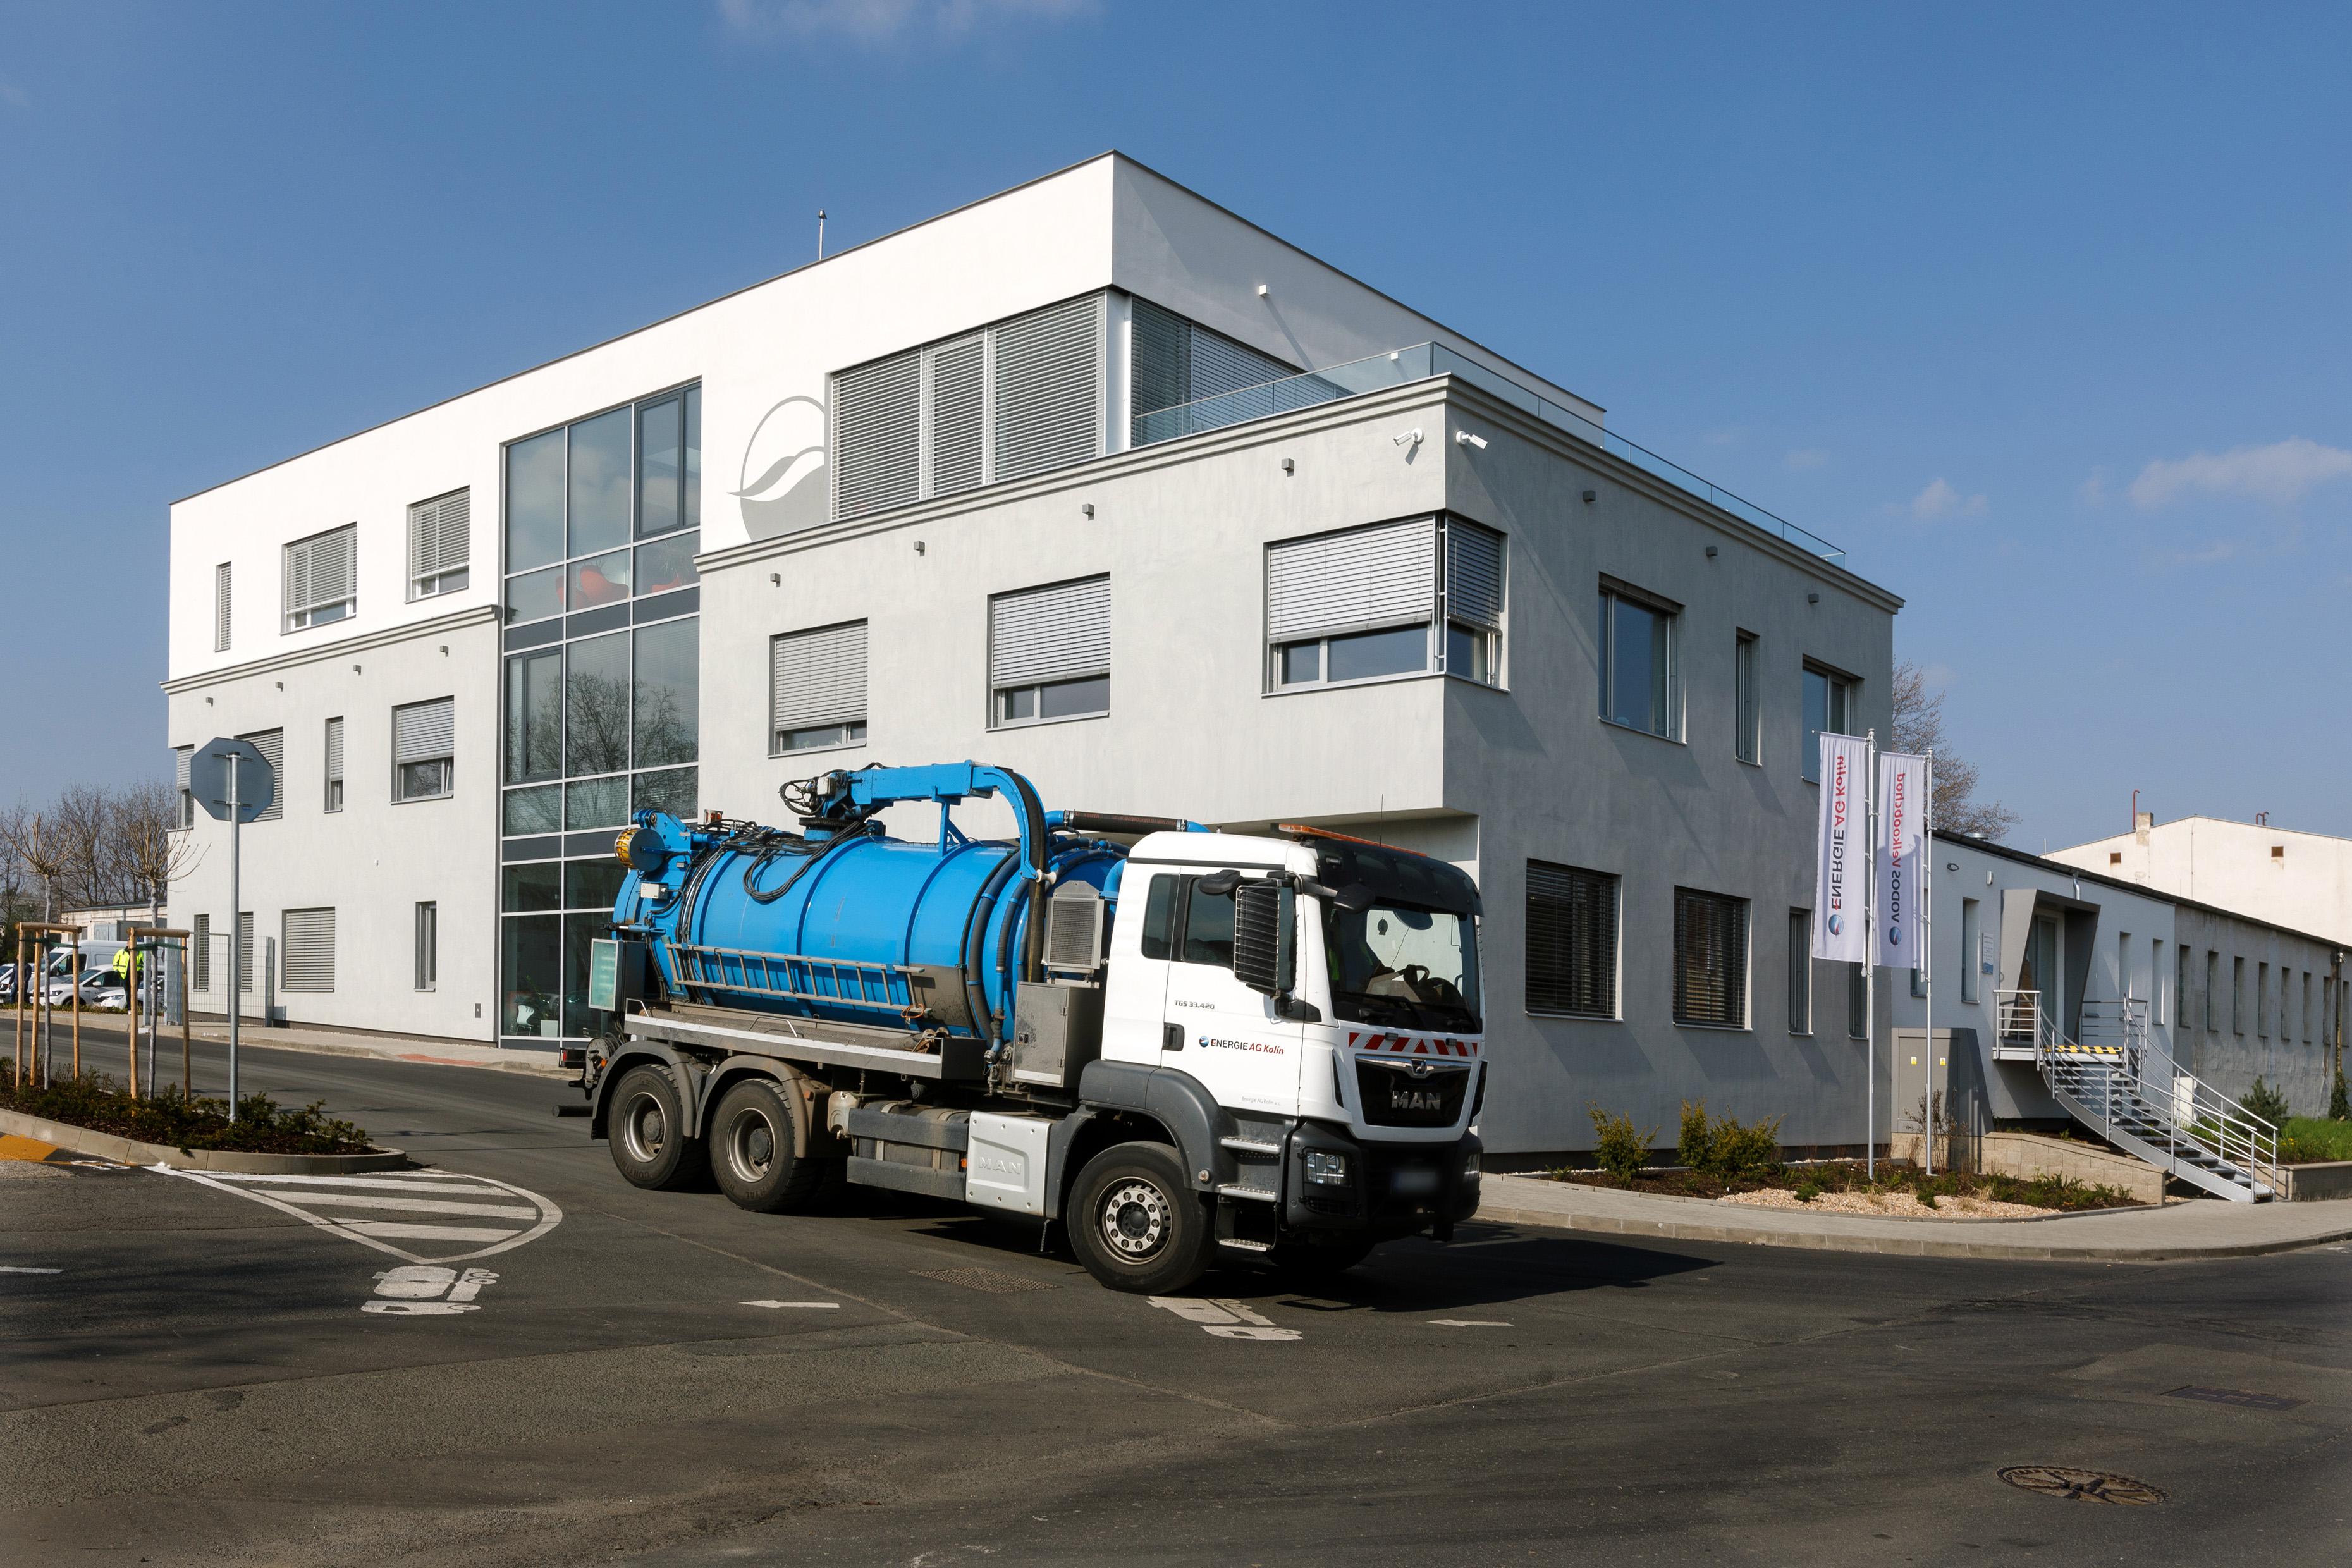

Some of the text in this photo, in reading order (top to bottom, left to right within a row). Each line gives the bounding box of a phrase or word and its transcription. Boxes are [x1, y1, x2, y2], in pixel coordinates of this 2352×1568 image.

[1189, 1001, 1215, 1010] 33.420
[1211, 1039, 1284, 1055] ENERGIE AG Kolín
[1392, 1090, 1441, 1110] MAN
[978, 1156, 1022, 1175] MAN
